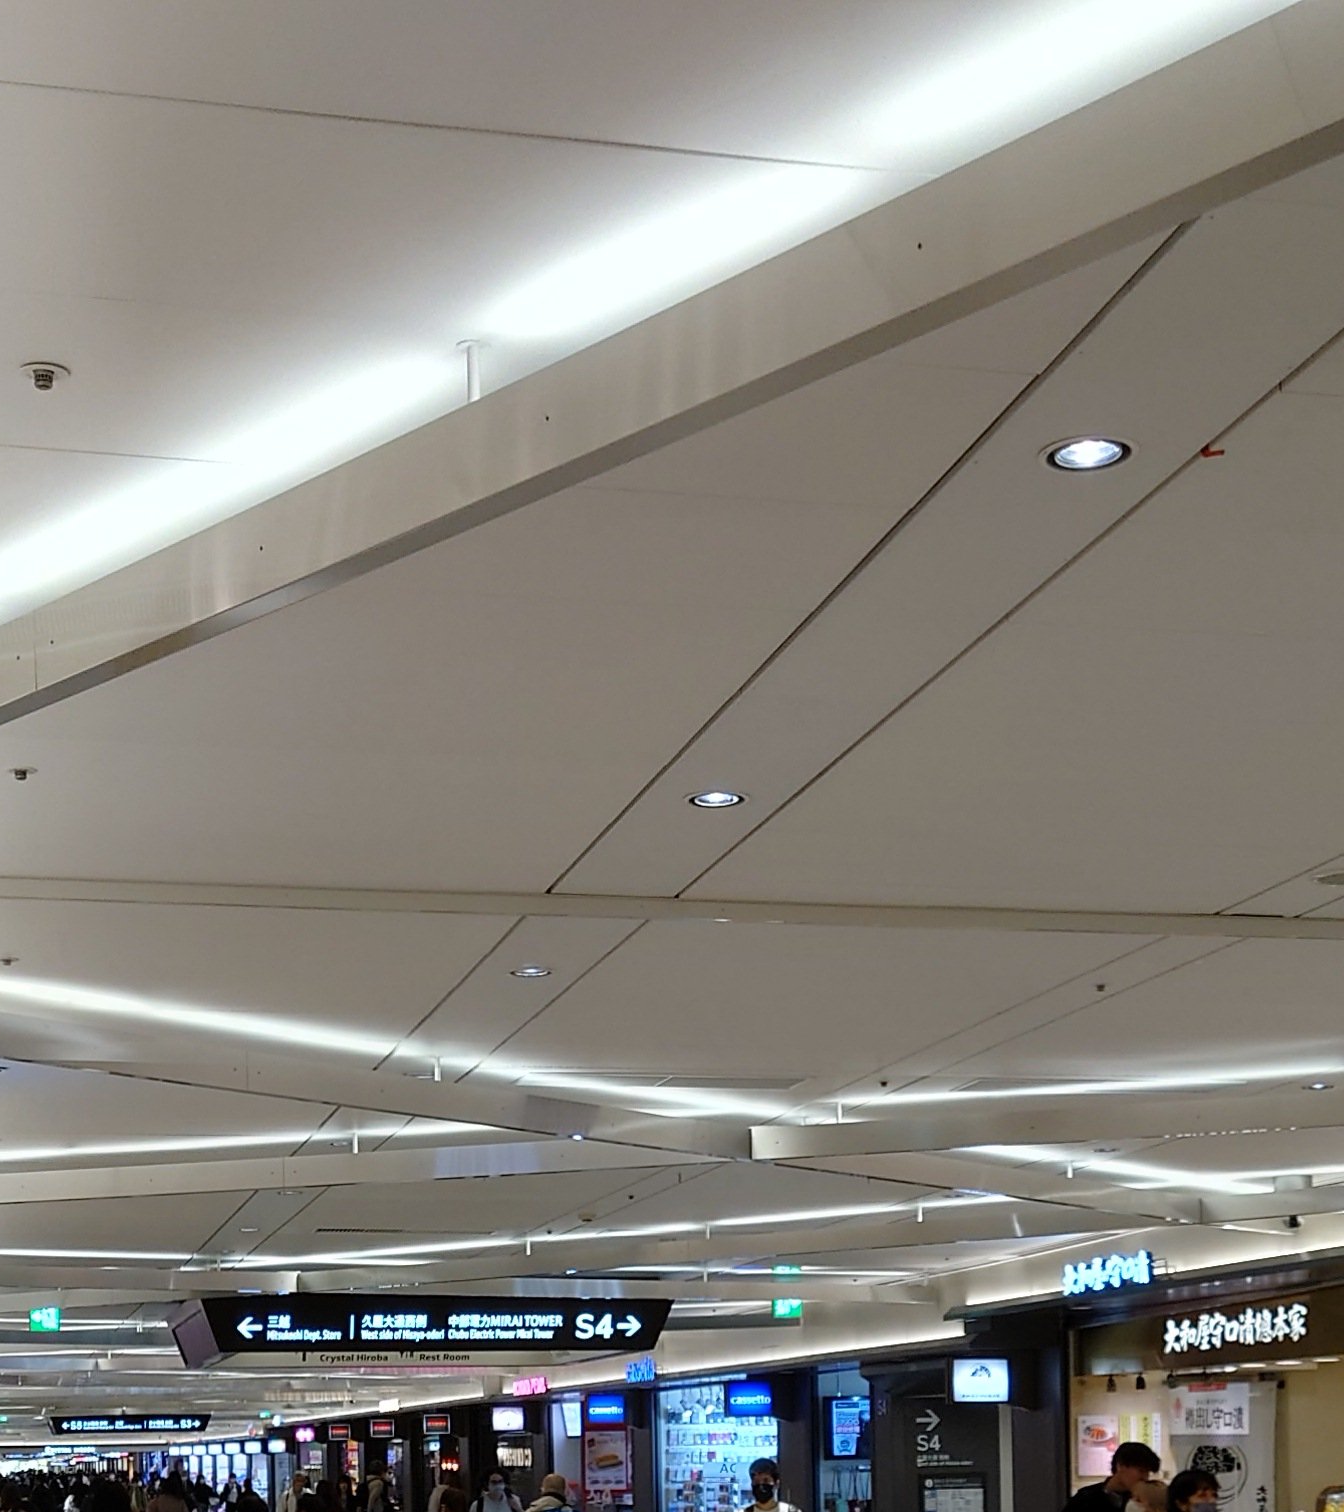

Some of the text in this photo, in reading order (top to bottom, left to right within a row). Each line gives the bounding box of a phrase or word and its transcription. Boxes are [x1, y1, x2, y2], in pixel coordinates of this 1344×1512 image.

[524, 1314, 563, 1327] TOWER
[575, 1313, 614, 1339] S4
[319, 1354, 389, 1364] Crystal Hiroba
[419, 1353, 470, 1361] Rest Room
[916, 1434, 941, 1451] S4
